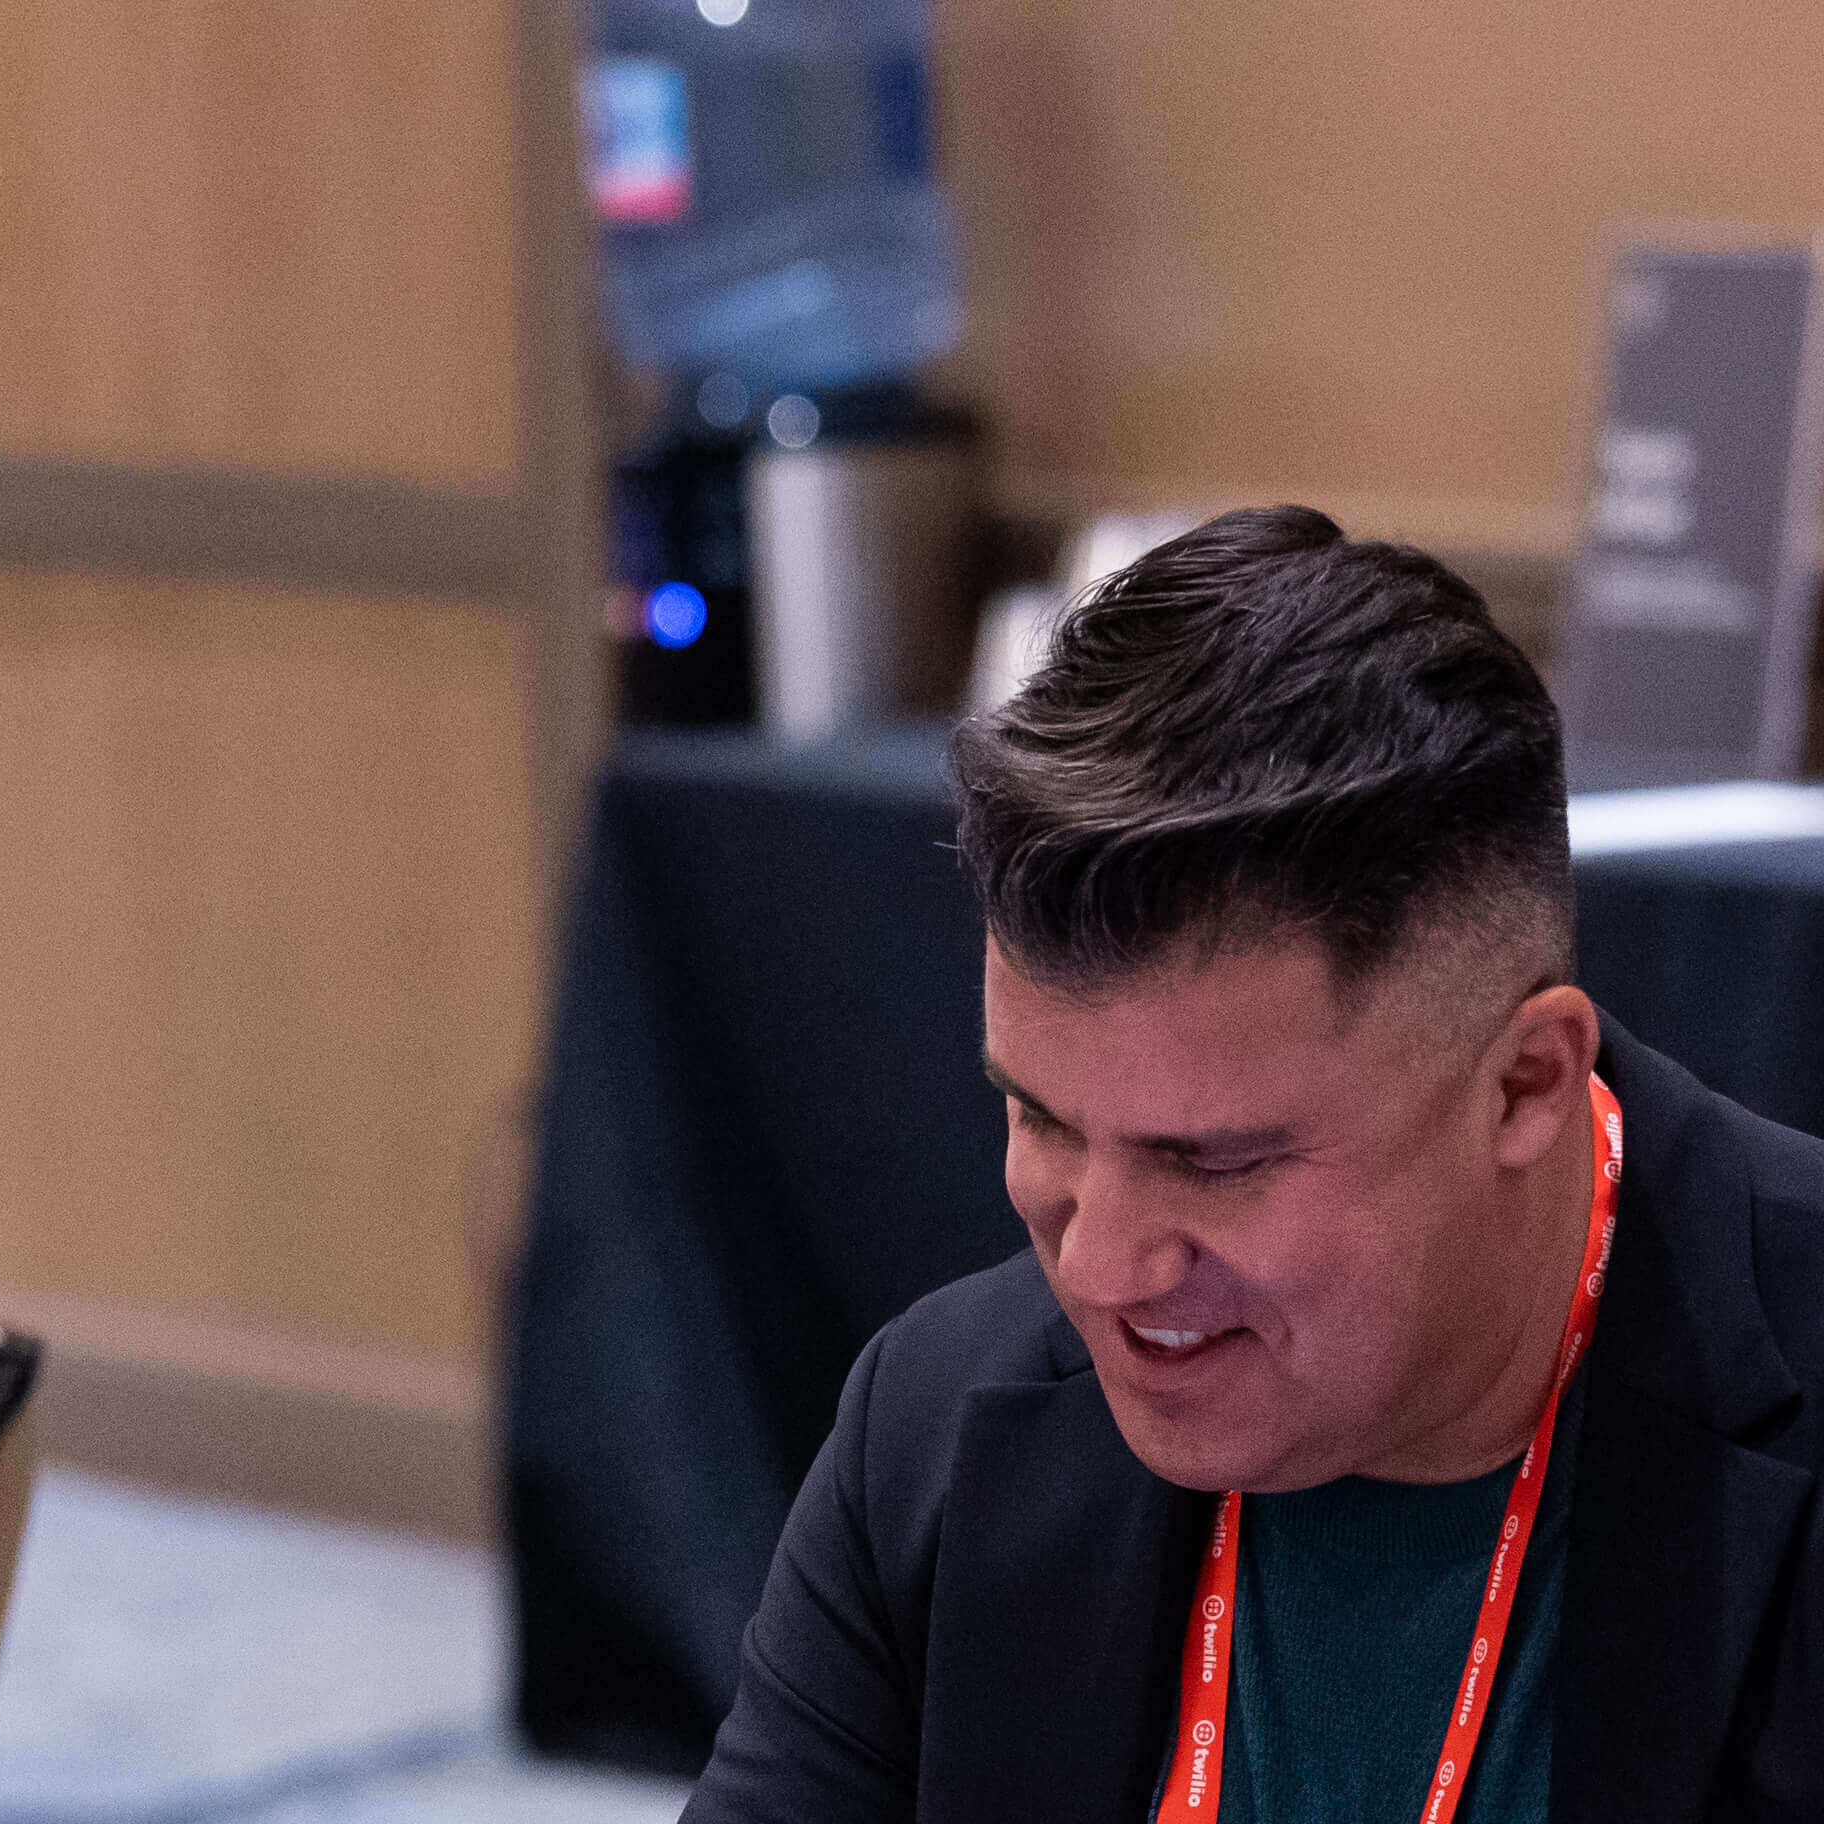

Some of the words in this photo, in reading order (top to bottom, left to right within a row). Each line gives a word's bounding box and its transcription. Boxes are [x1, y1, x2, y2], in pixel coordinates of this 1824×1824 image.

[1596, 1215, 1616, 1270] twilio
[1489, 1543, 1509, 1603] twilio
[1202, 1622, 1218, 1683] twilio
[1458, 1667, 1479, 1726] twilio
[1188, 1748, 1209, 1808] twilio
